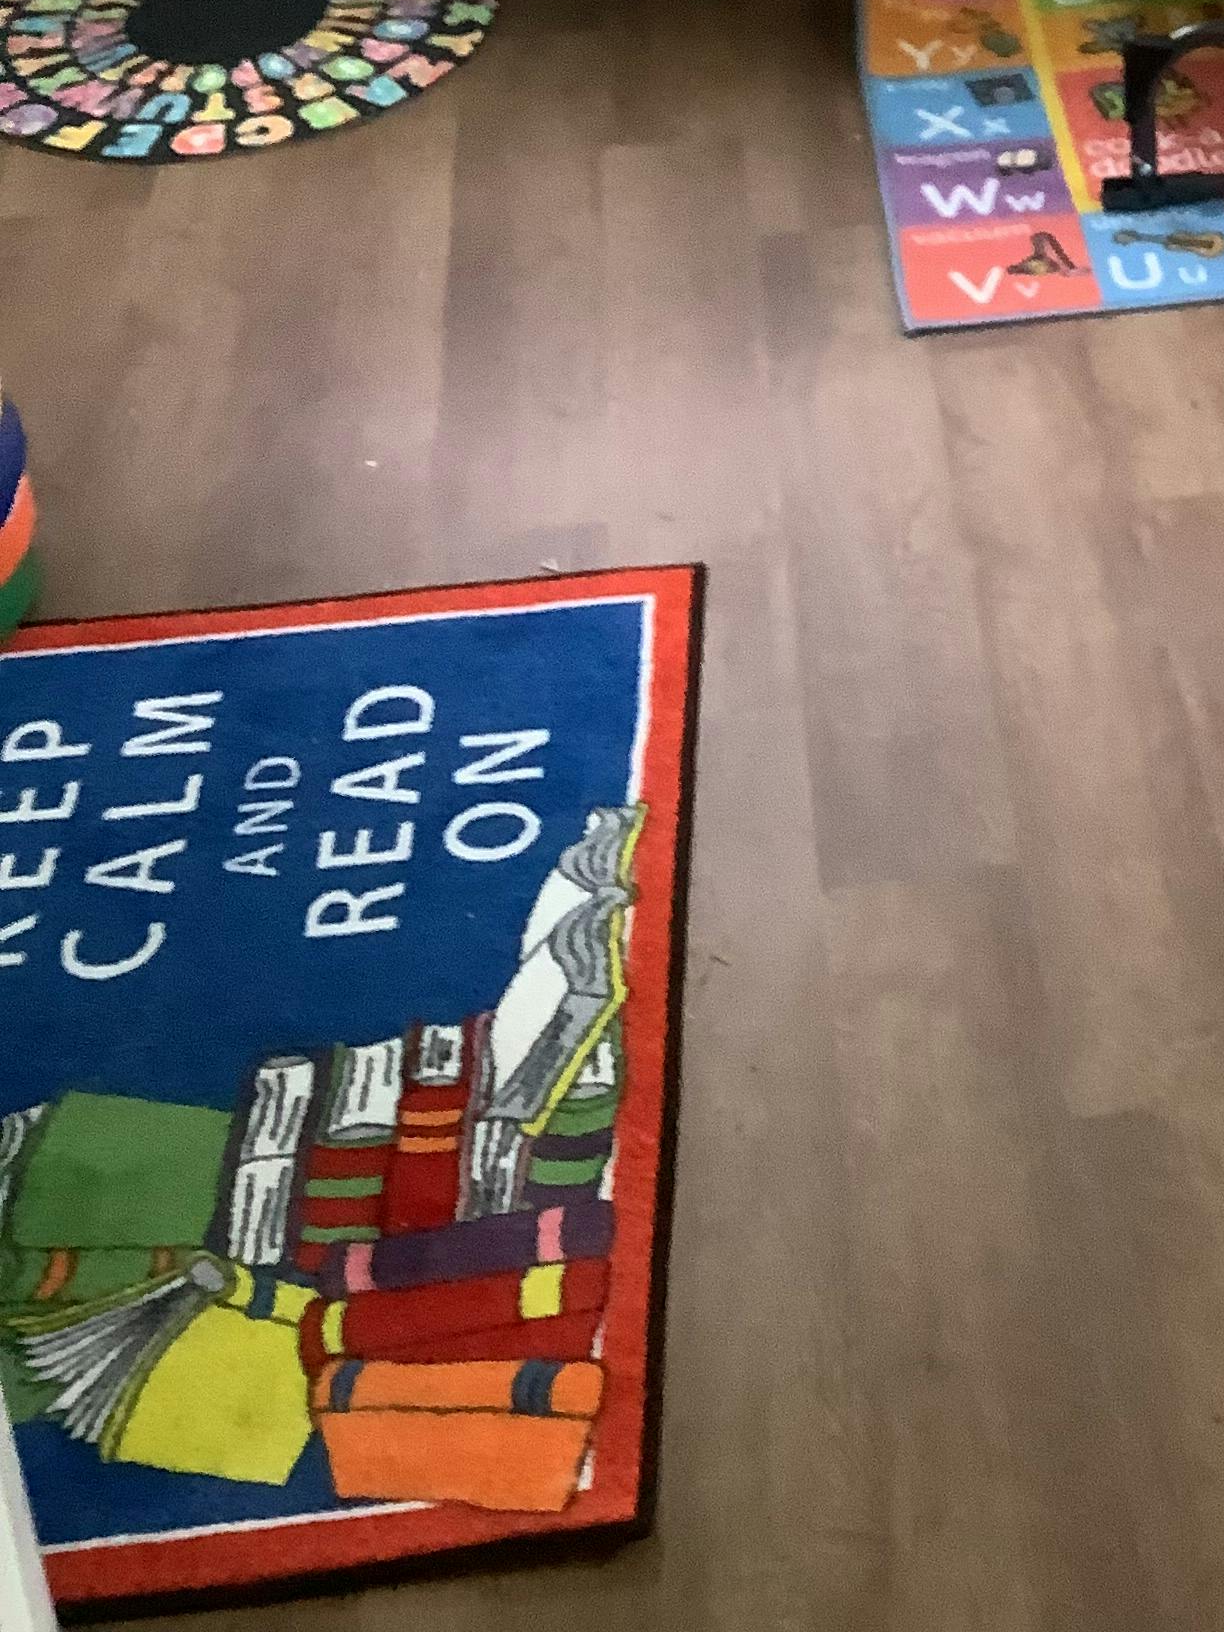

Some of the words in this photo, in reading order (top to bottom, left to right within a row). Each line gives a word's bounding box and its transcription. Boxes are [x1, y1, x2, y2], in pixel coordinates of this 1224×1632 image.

[59, 689, 225, 981] CALM
[223, 754, 302, 877] AND
[302, 683, 437, 939] READ
[440, 726, 552, 863] ON
